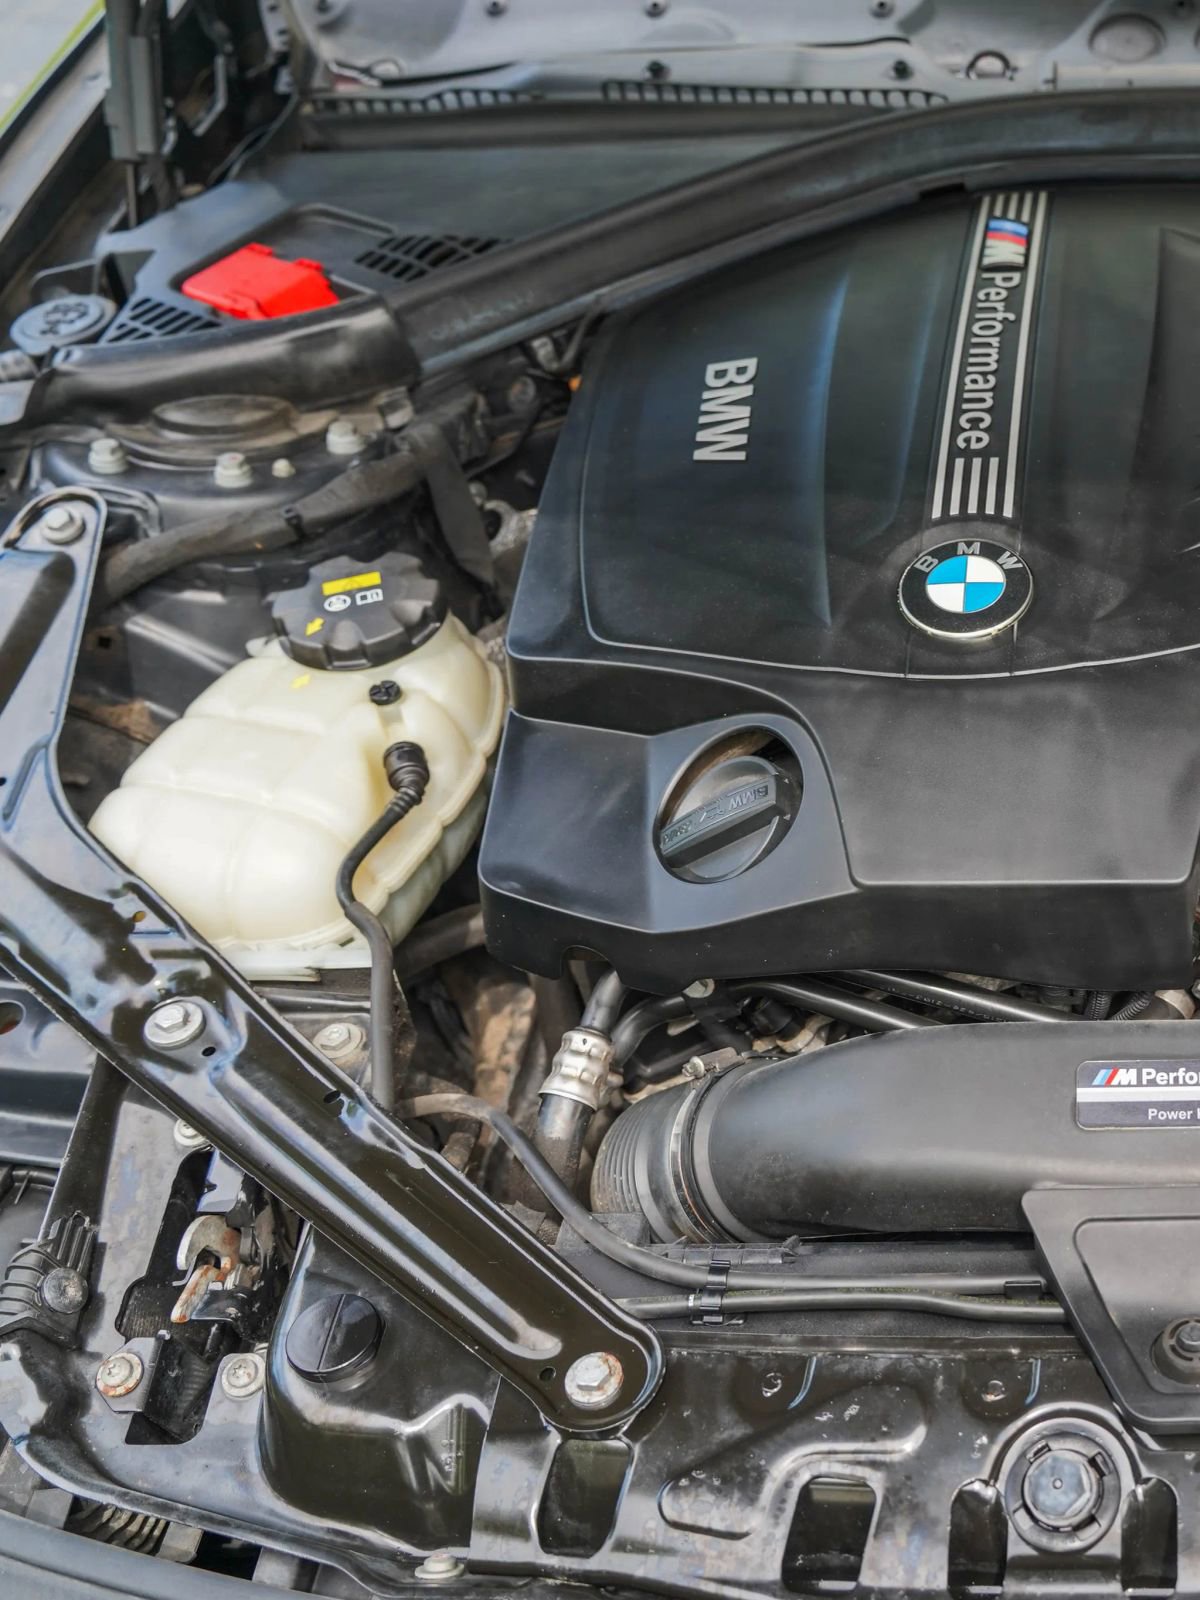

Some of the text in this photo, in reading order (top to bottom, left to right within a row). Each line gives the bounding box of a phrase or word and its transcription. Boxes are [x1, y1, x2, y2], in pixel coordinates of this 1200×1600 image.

[956, 272, 1021, 450] Performance
[693, 357, 758, 461] BMW
[914, 541, 1024, 573] BMW
[728, 784, 769, 811] BMW
[1147, 1107, 1193, 1120] Power
